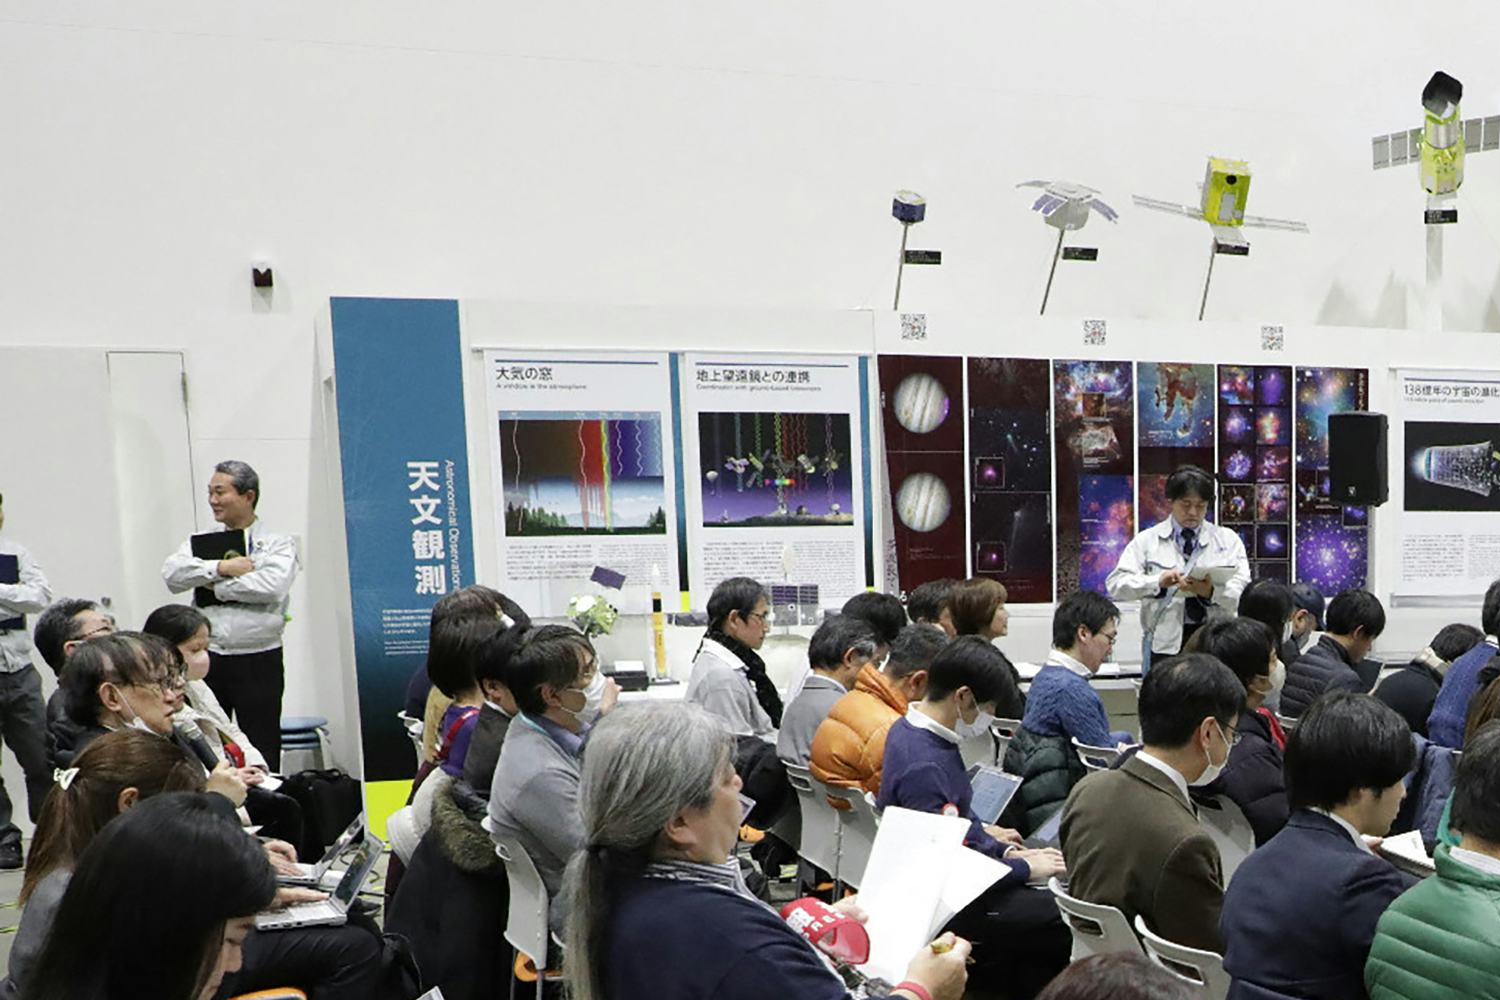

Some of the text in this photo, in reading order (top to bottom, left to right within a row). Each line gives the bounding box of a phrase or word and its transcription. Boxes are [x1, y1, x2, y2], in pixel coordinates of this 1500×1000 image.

[495, 366, 553, 381] 大気の窓
[696, 370, 811, 384] 地上望遠鏡との連携
[1404, 385, 1500, 398] 138億年の宇宙の進化
[445, 459, 458, 527] Astronomical
[406, 461, 446, 595] 天文観測
